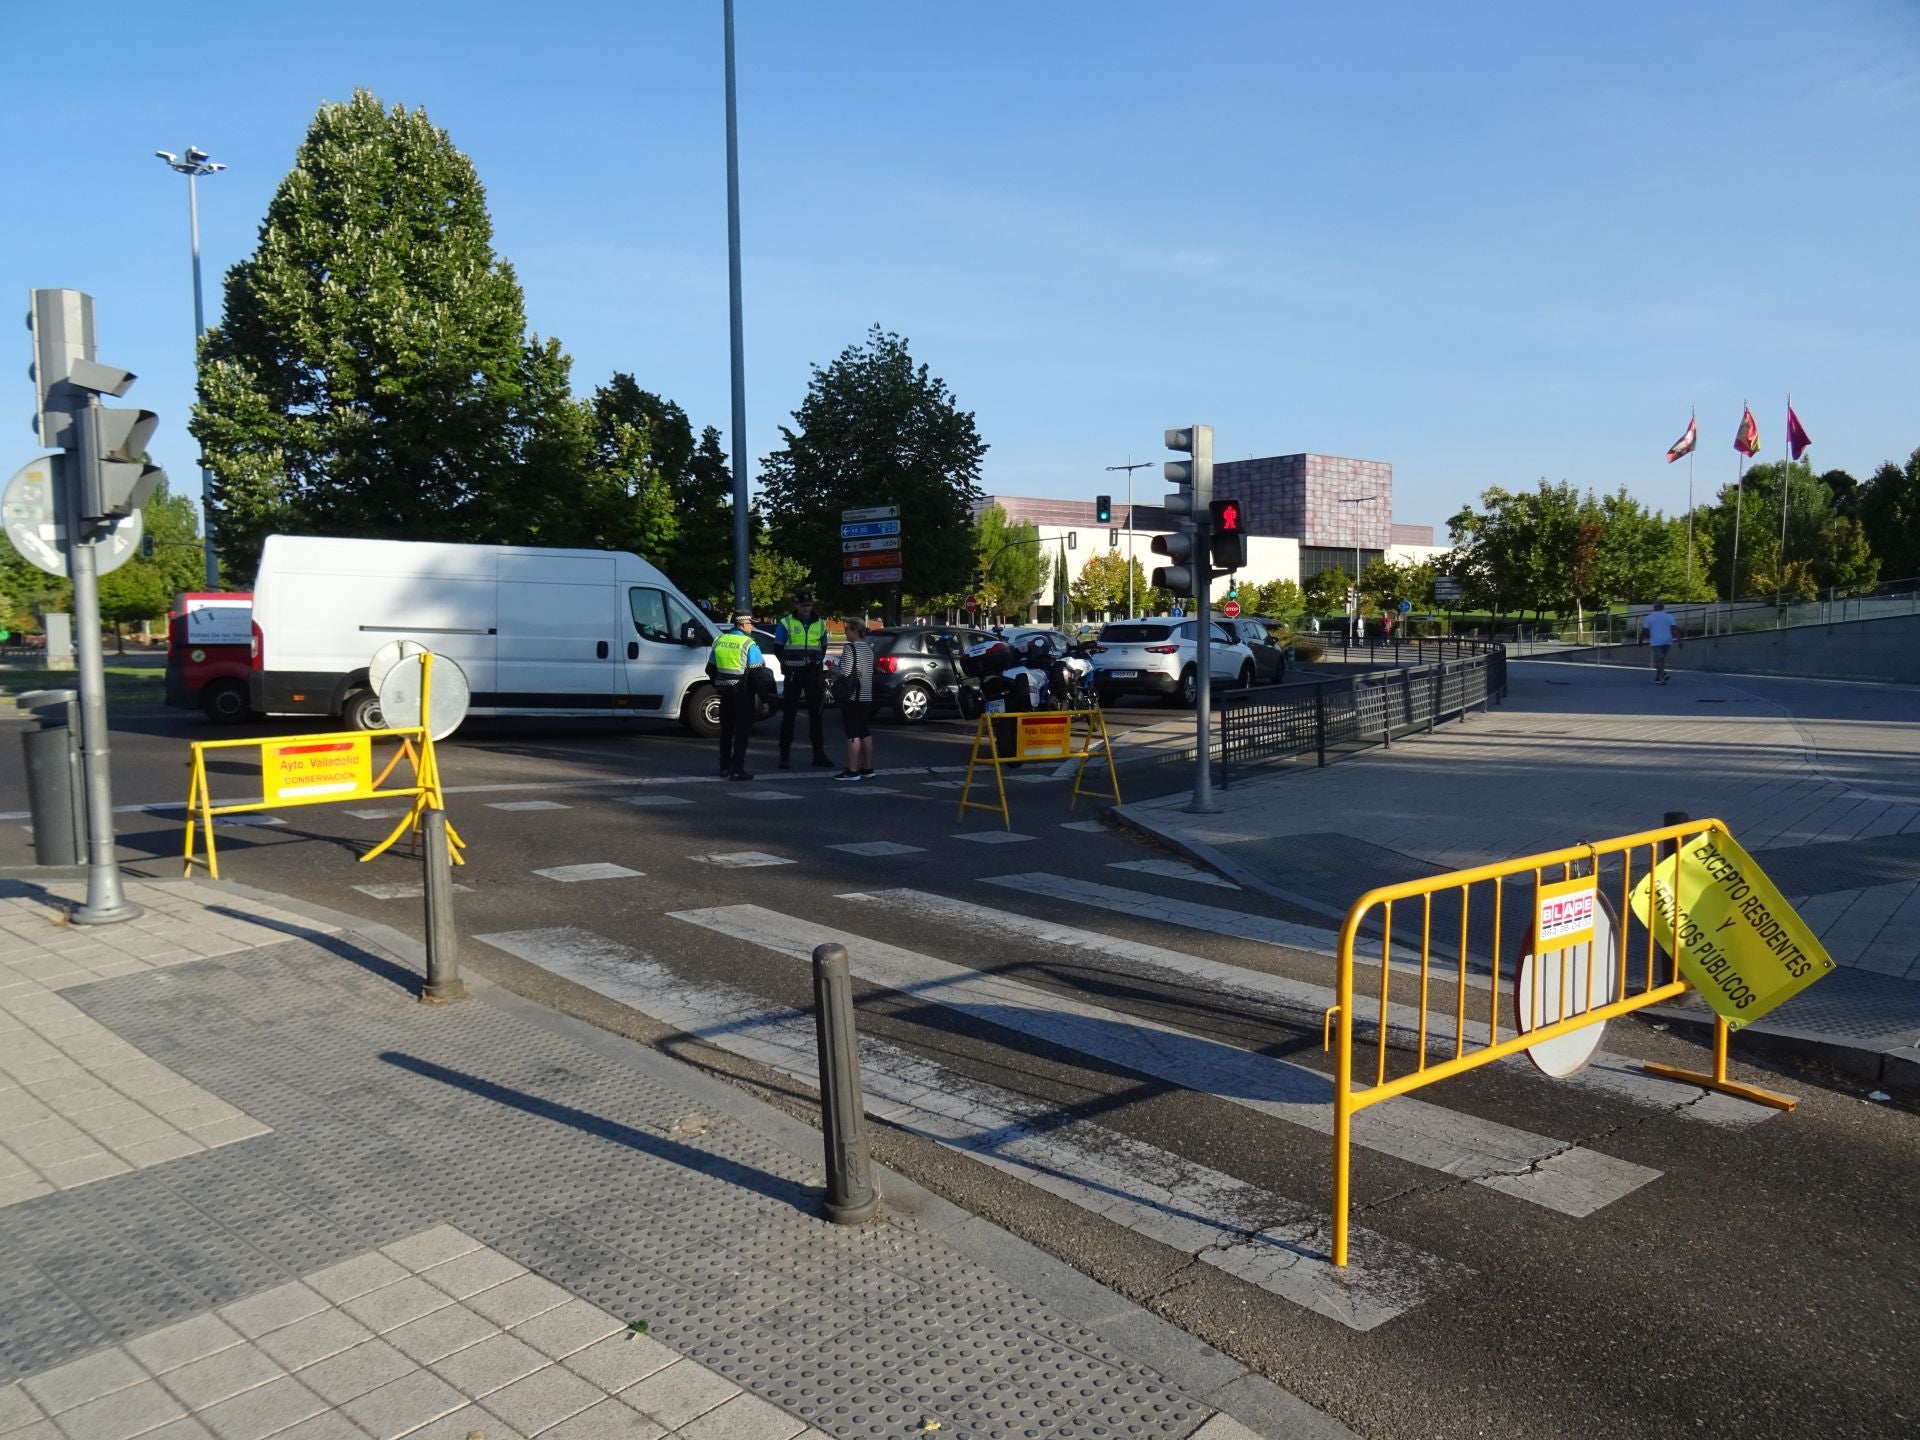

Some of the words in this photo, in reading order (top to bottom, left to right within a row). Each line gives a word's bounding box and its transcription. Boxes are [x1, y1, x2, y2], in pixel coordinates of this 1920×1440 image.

[309, 756, 360, 769] Valladolid
[1542, 895, 1592, 924] BLAPE
[1693, 842, 1751, 901] EXCEPTO
[1738, 895, 1812, 979] RESIDENTES
[1716, 916, 1737, 933] Y
[1692, 941, 1756, 1010] PÚBLICOS
